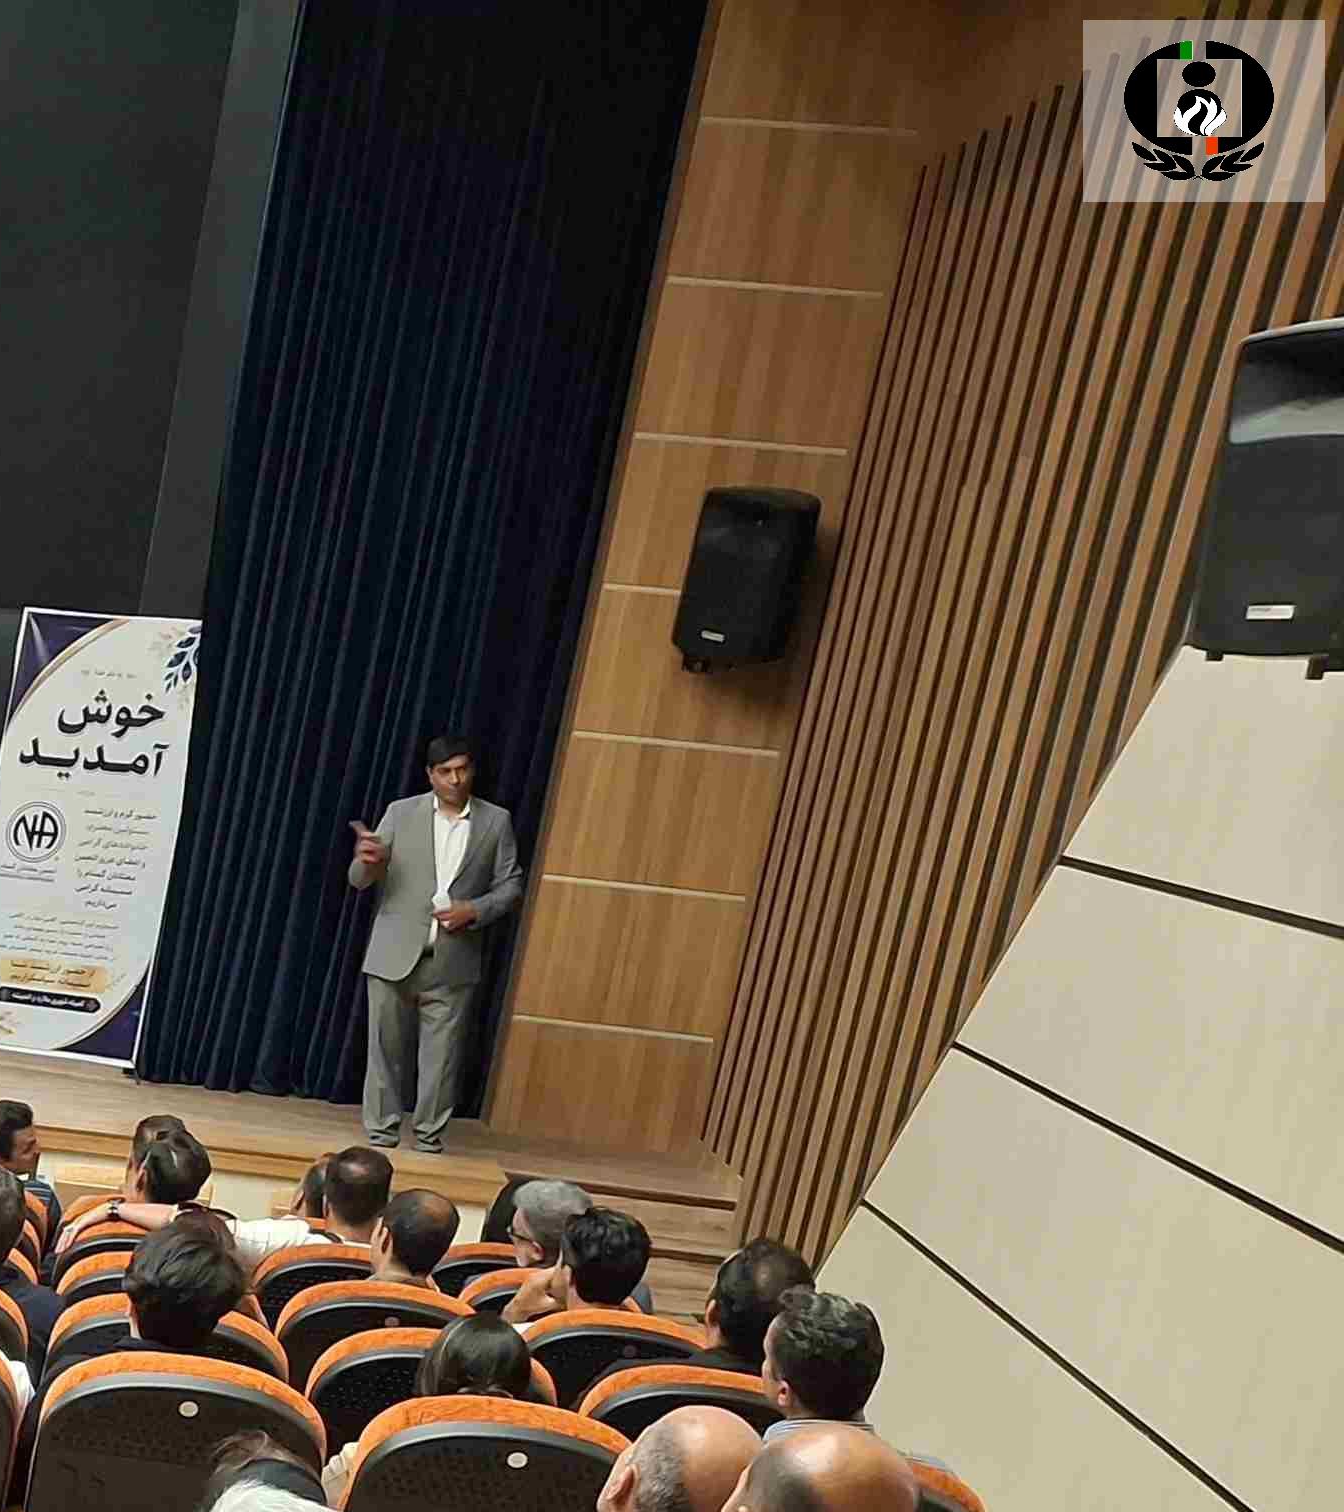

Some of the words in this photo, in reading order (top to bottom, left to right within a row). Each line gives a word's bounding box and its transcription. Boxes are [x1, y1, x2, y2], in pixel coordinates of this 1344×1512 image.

[58, 688, 166, 738] خوش
[18, 736, 170, 779] آمدید
[12, 809, 60, 851] NA
